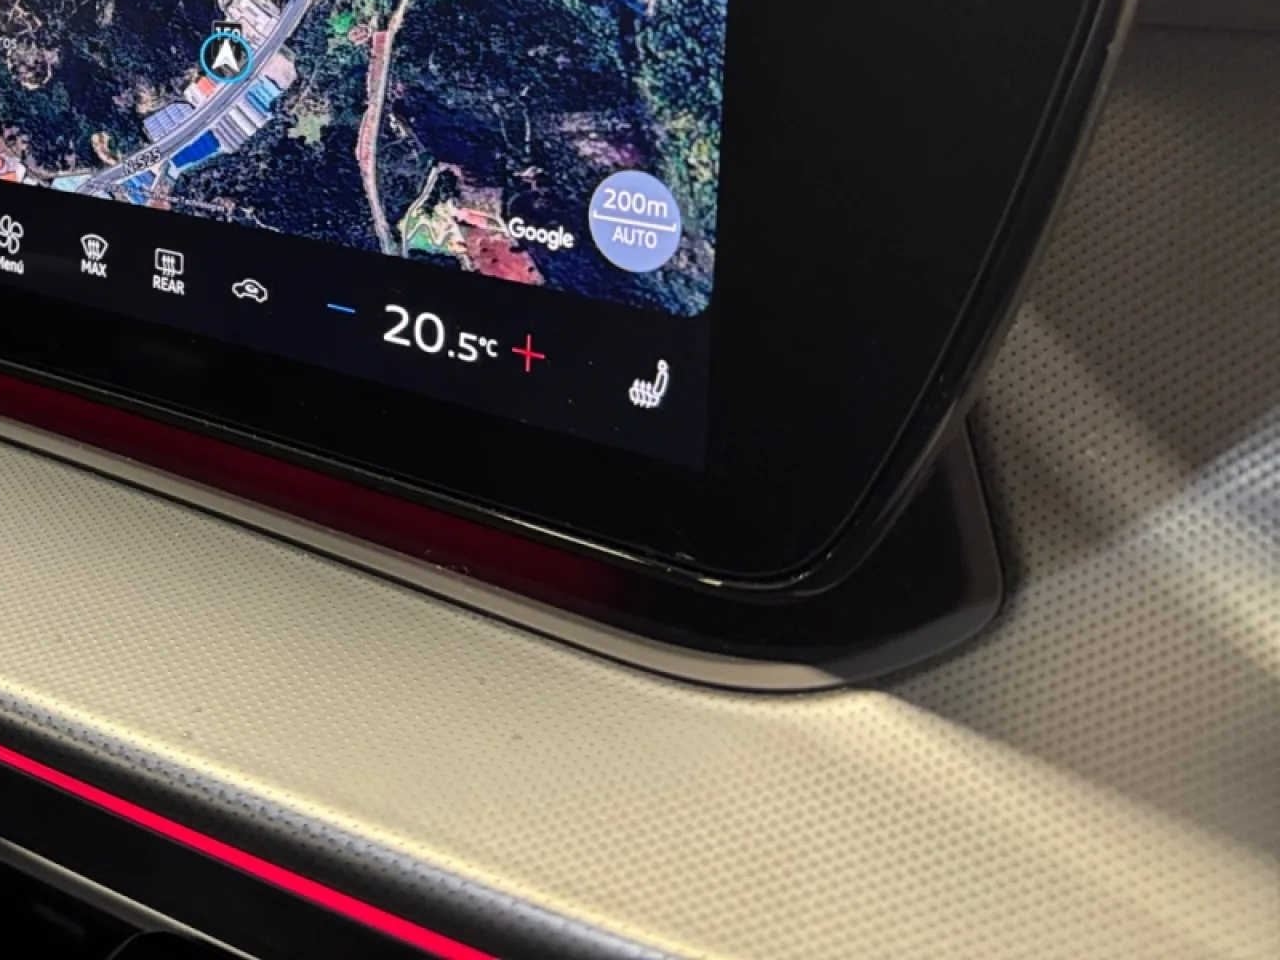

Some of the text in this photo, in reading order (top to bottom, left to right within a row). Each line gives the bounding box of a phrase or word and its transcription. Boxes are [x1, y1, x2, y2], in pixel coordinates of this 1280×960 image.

[601, 187, 669, 220] 200m
[508, 216, 576, 252] Google
[611, 224, 658, 250] AUTO
[80, 257, 108, 279] MAX
[151, 273, 186, 296] REAR
